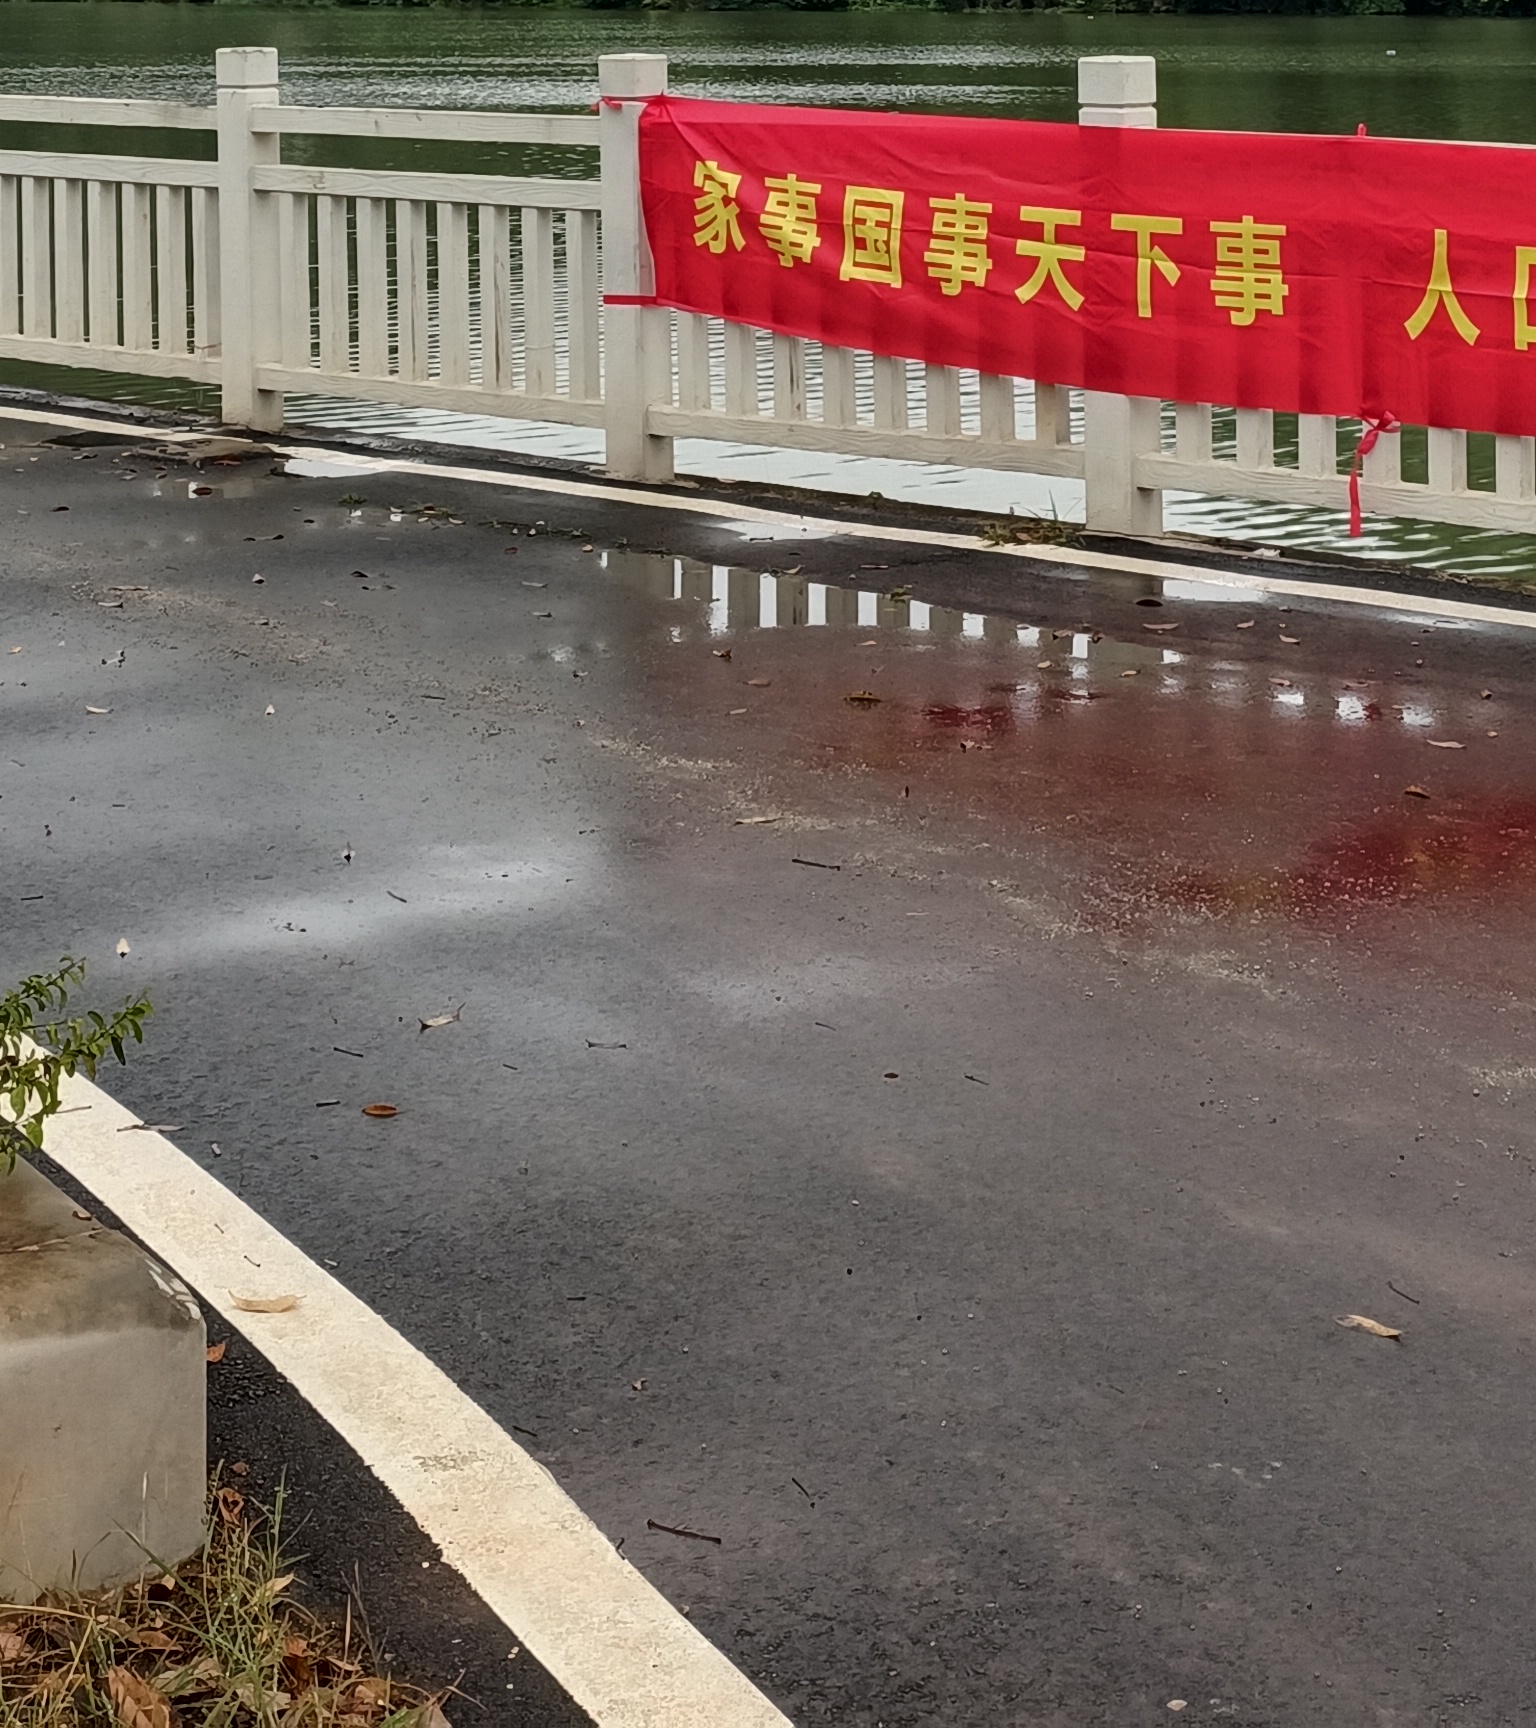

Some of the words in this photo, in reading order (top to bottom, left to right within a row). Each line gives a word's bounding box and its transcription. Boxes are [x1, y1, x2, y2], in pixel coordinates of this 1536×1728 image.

[692, 160, 1290, 327] 家事国事天下事
